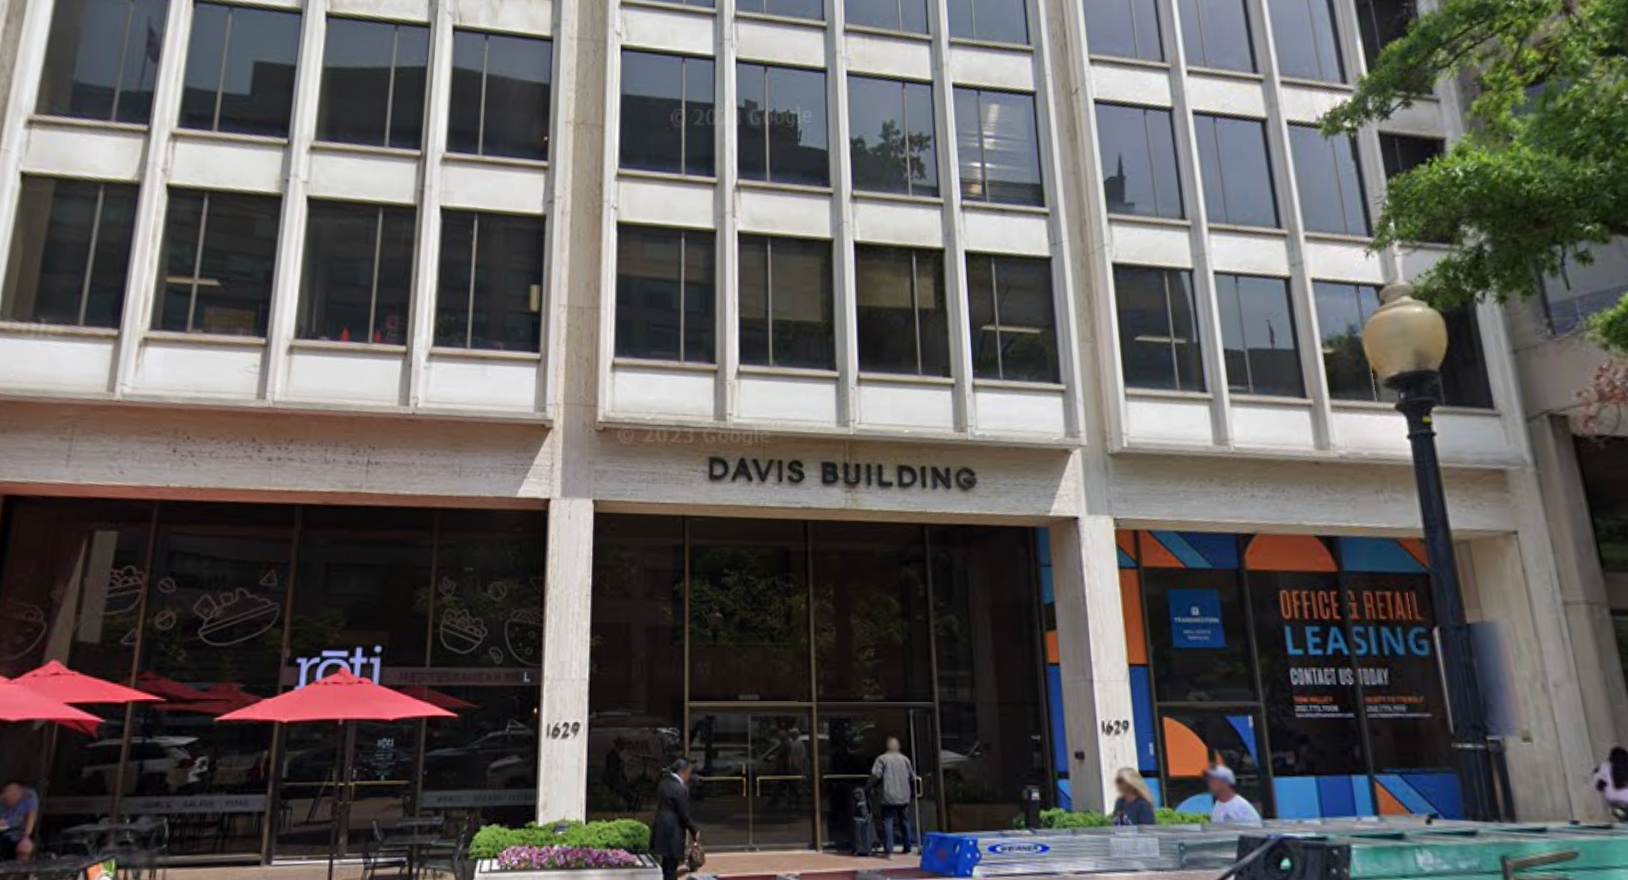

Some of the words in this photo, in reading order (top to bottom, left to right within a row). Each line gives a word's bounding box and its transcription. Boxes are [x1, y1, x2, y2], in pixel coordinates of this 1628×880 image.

[708, 456, 806, 484] DAVIS
[821, 461, 978, 492] BUILDING
[1279, 590, 1341, 620] OFFICE
[1363, 591, 1426, 620] RETAIL
[1284, 625, 1431, 656] LEASING
[1289, 667, 1337, 686] CONTACT
[1338, 668, 1355, 686] US
[1358, 668, 1390, 686] TODAY
[546, 721, 581, 740] 1629
[1101, 720, 1129, 736] 1629
